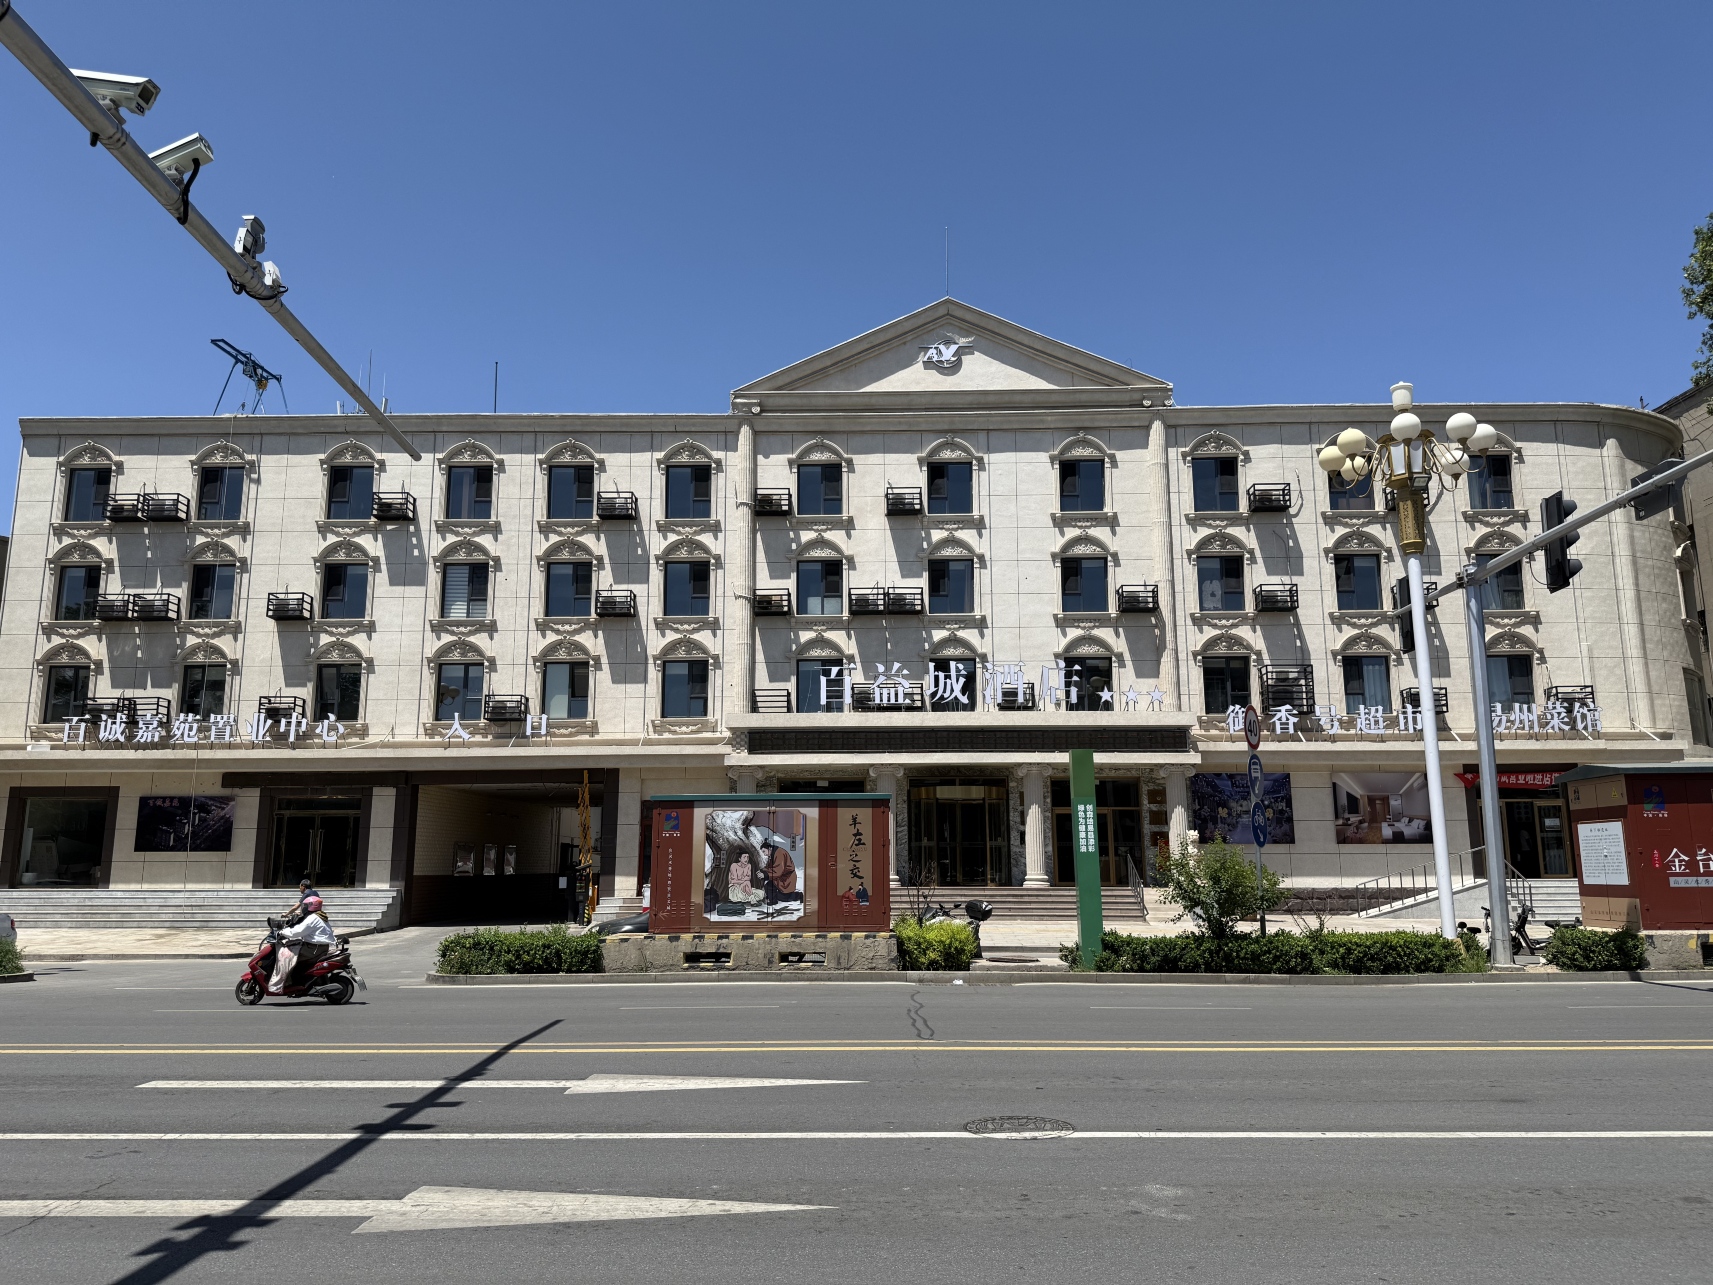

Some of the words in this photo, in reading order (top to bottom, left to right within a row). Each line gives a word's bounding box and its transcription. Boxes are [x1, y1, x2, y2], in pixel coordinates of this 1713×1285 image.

[814, 660, 1082, 706] 百益城酒店
[62, 712, 345, 743] 百诚嘉苑置业中心
[1247, 719, 1258, 737] 40
[848, 813, 866, 880] 羊左之交
